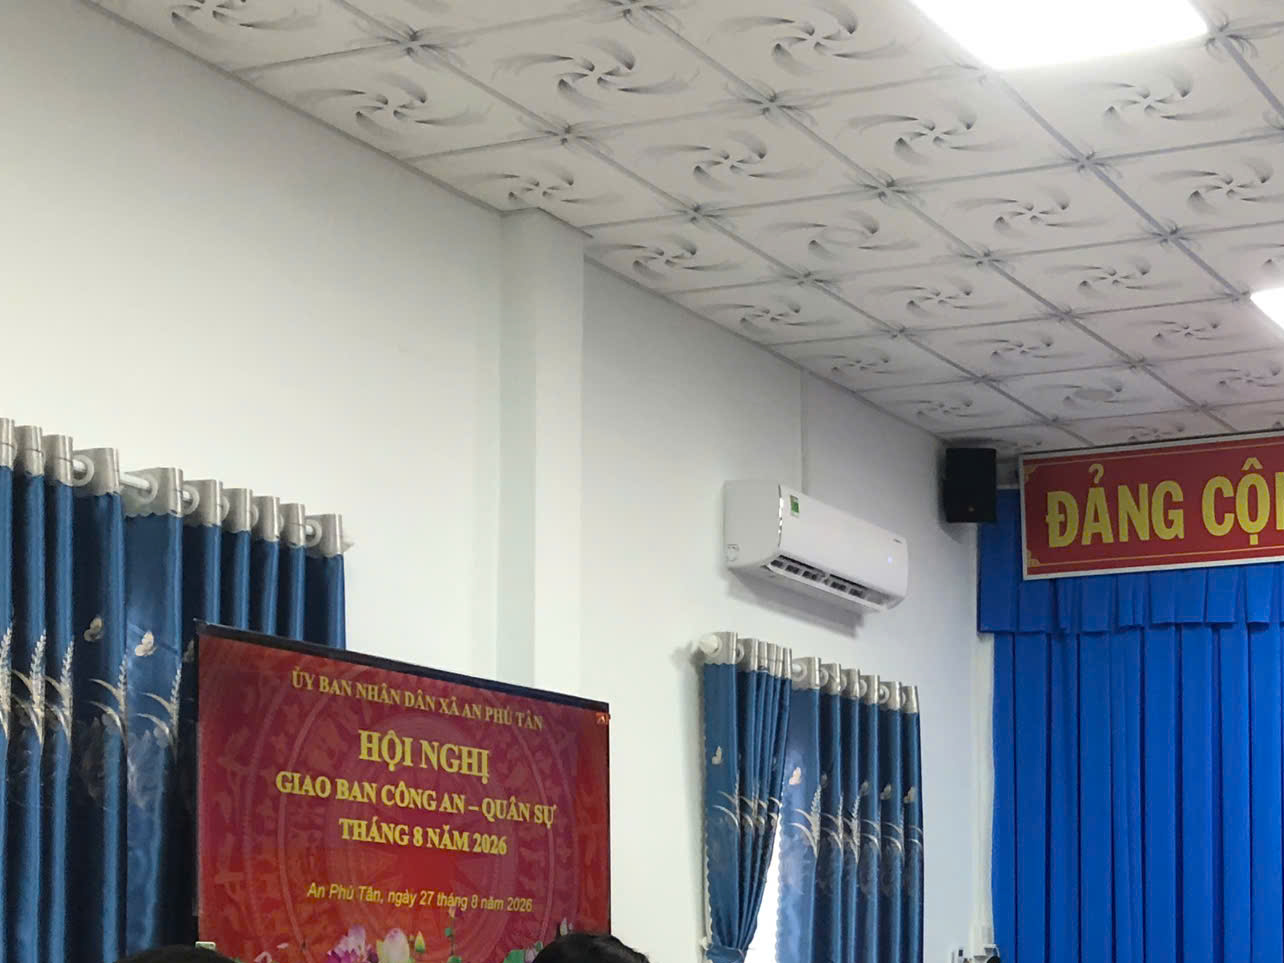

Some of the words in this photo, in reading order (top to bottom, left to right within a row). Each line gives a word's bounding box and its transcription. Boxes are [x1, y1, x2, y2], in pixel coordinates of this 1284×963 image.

[1046, 466, 1185, 548] ĐẢNG
[291, 667, 315, 690] ỦY
[319, 676, 352, 697] BAN
[355, 682, 402, 705] NHÂN
[404, 689, 436, 712] DÂN
[439, 697, 460, 715] XÃ
[462, 702, 481, 721] AN
[485, 705, 512, 726] PHÚ
[517, 710, 543, 730] TÂN
[358, 729, 414, 772] HỘI
[420, 740, 490, 785] NGHỊ
[275, 771, 331, 798] GIAO
[336, 779, 377, 804] BAN
[381, 780, 437, 811] CÔNG
[439, 793, 465, 814] AN
[482, 796, 530, 822] QUÂN
[534, 803, 558, 830] SỰ
[338, 815, 410, 846] THÁNG
[413, 828, 423, 847] 8
[426, 824, 470, 852] NĂM
[472, 833, 508, 855] 2026
[307, 882, 325, 898] An
[329, 883, 353, 900] Phú
[388, 889, 417, 908] ngày
[419, 890, 434, 905] 27
[437, 892, 468, 911] tháng
[471, 894, 478, 909] 8
[481, 895, 504, 911] năm
[507, 897, 533, 913] 2026
